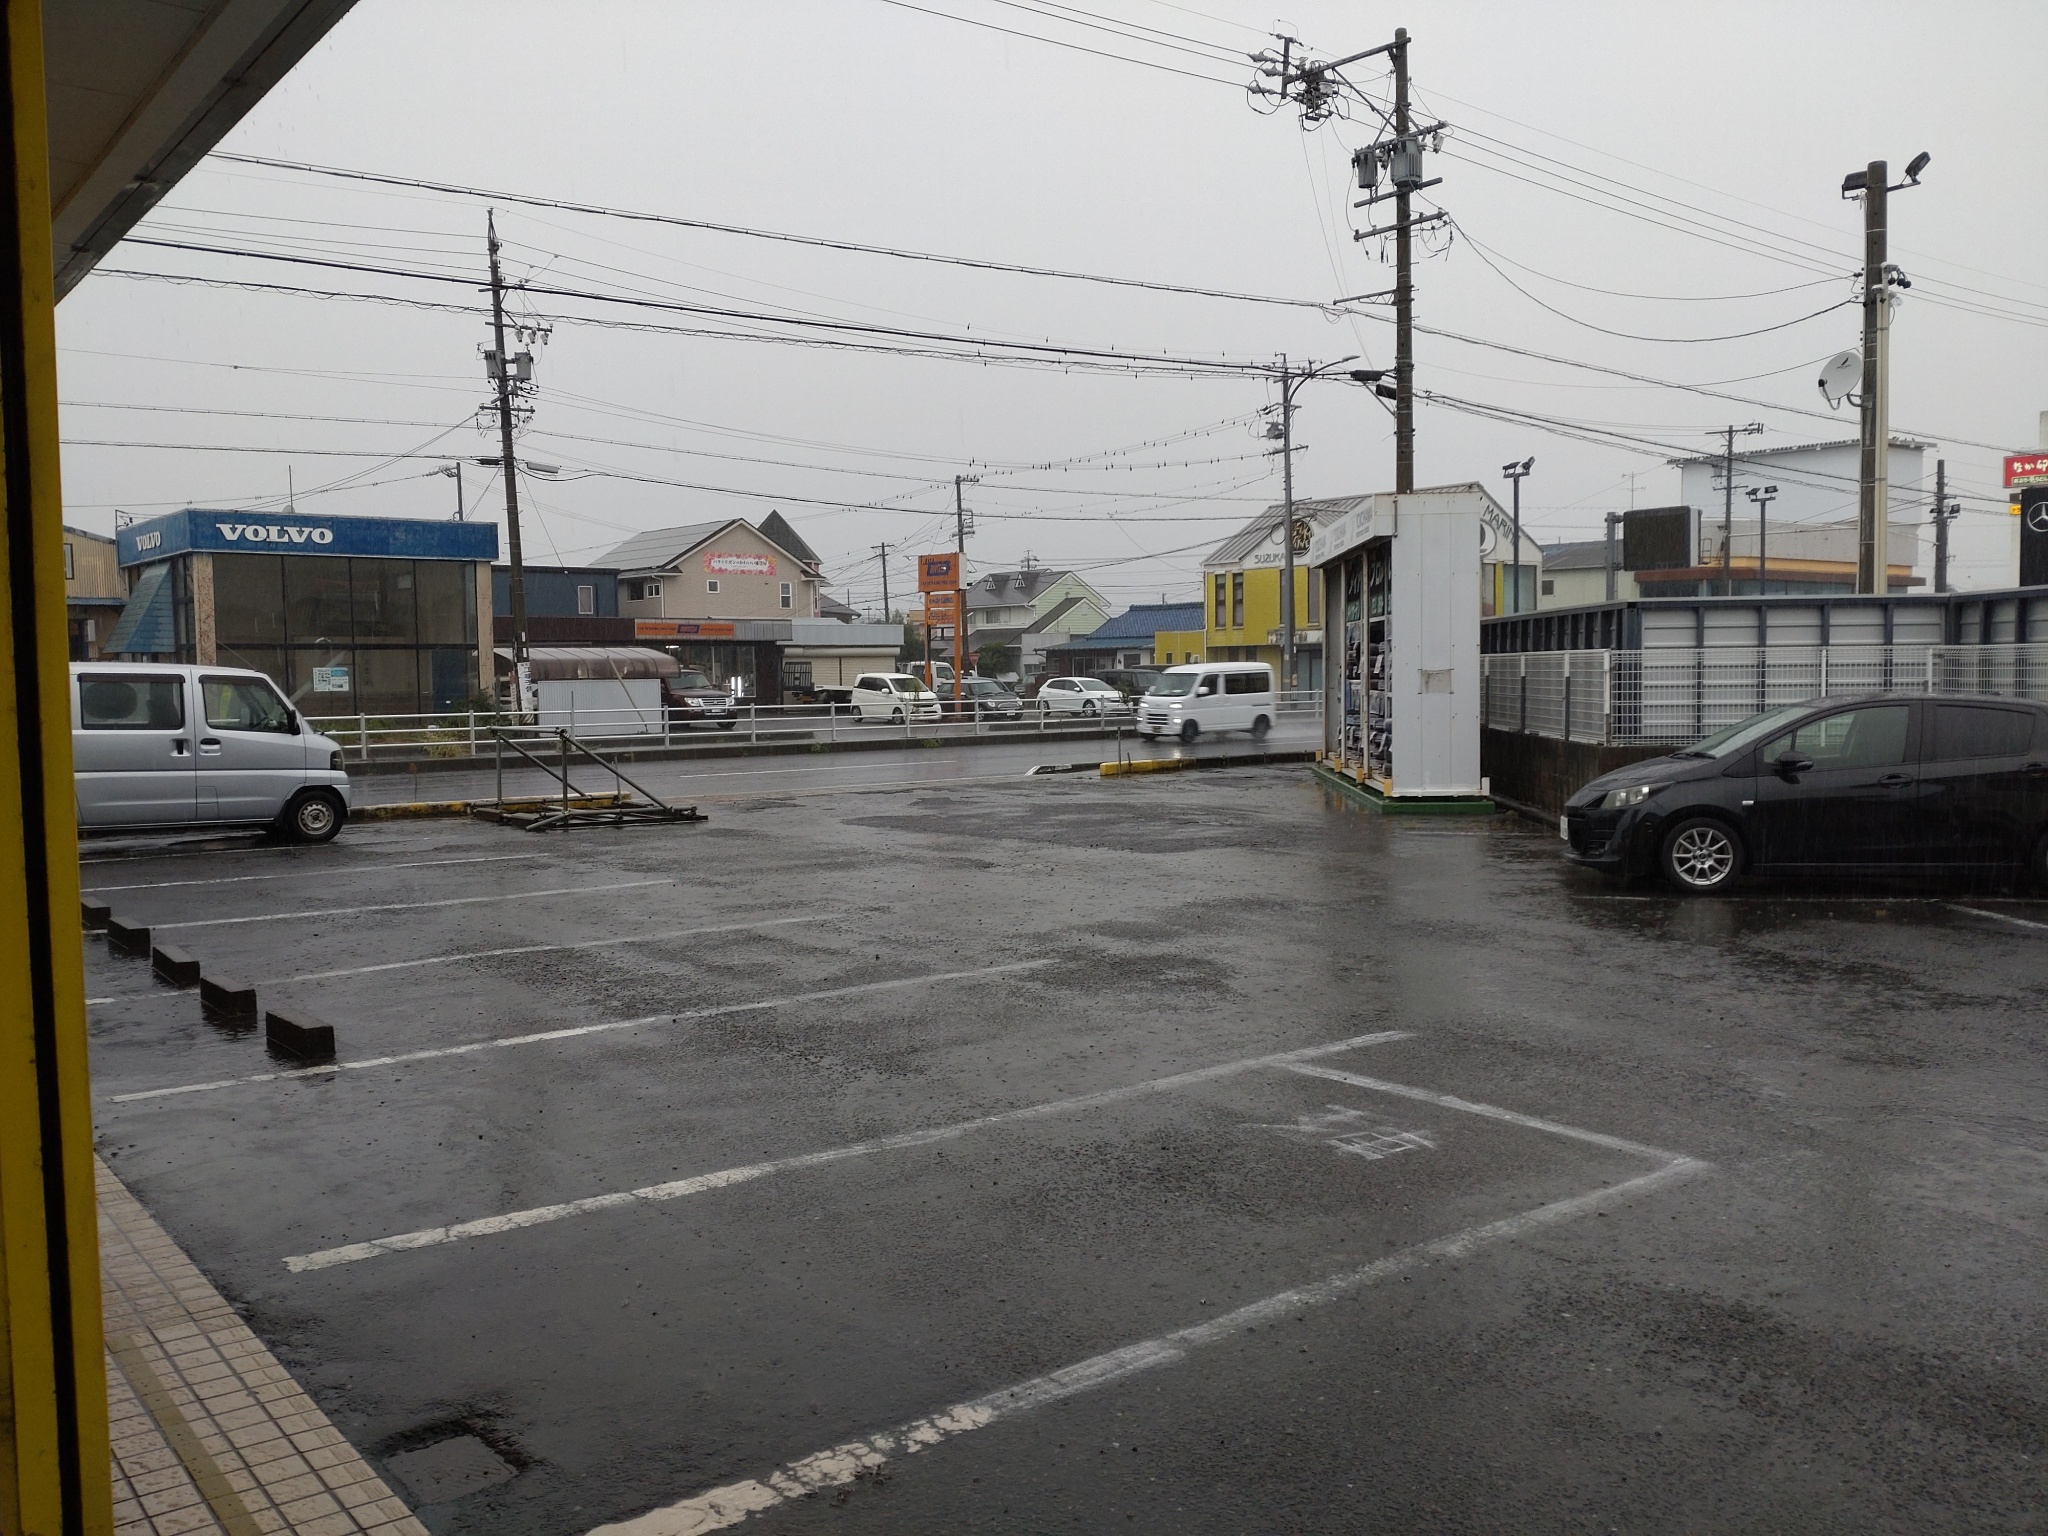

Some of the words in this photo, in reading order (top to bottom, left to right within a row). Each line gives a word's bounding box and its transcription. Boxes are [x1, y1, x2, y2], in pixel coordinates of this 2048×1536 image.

[216, 523, 334, 545] VOLVO
[1483, 504, 1521, 546] MARIN
[136, 531, 161, 552] VOLVO
